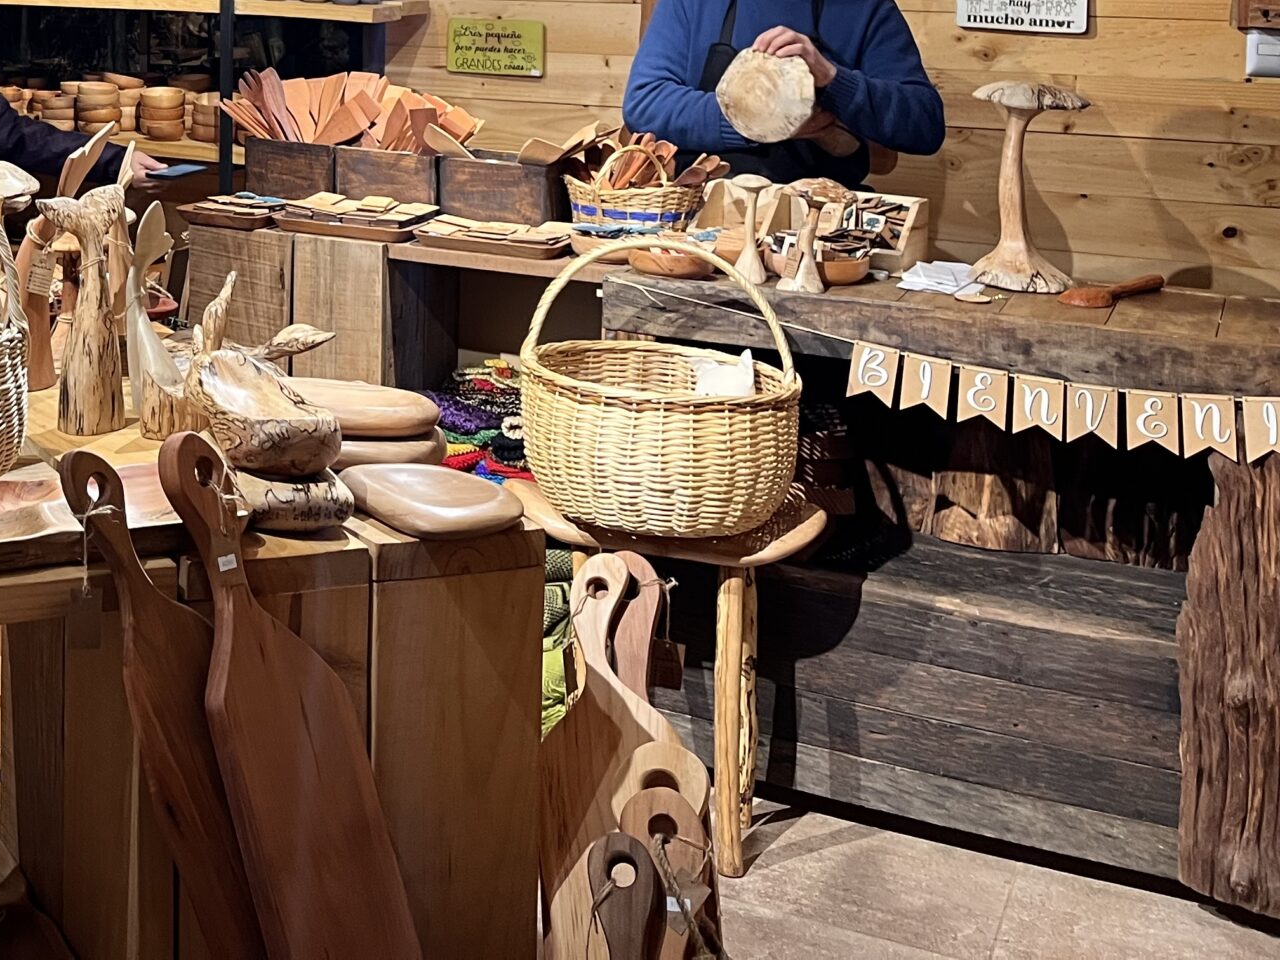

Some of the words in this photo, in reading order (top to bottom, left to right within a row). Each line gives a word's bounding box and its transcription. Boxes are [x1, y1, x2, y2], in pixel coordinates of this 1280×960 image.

[966, 12, 1026, 27] mucho
[460, 24, 484, 38] Eres
[484, 30, 523, 45] pequeño
[454, 43, 473, 54] pero
[474, 45, 502, 55] puedes
[503, 45, 527, 55] hacer
[454, 56, 502, 71] GRANDES
[503, 63, 526, 72] cosas
